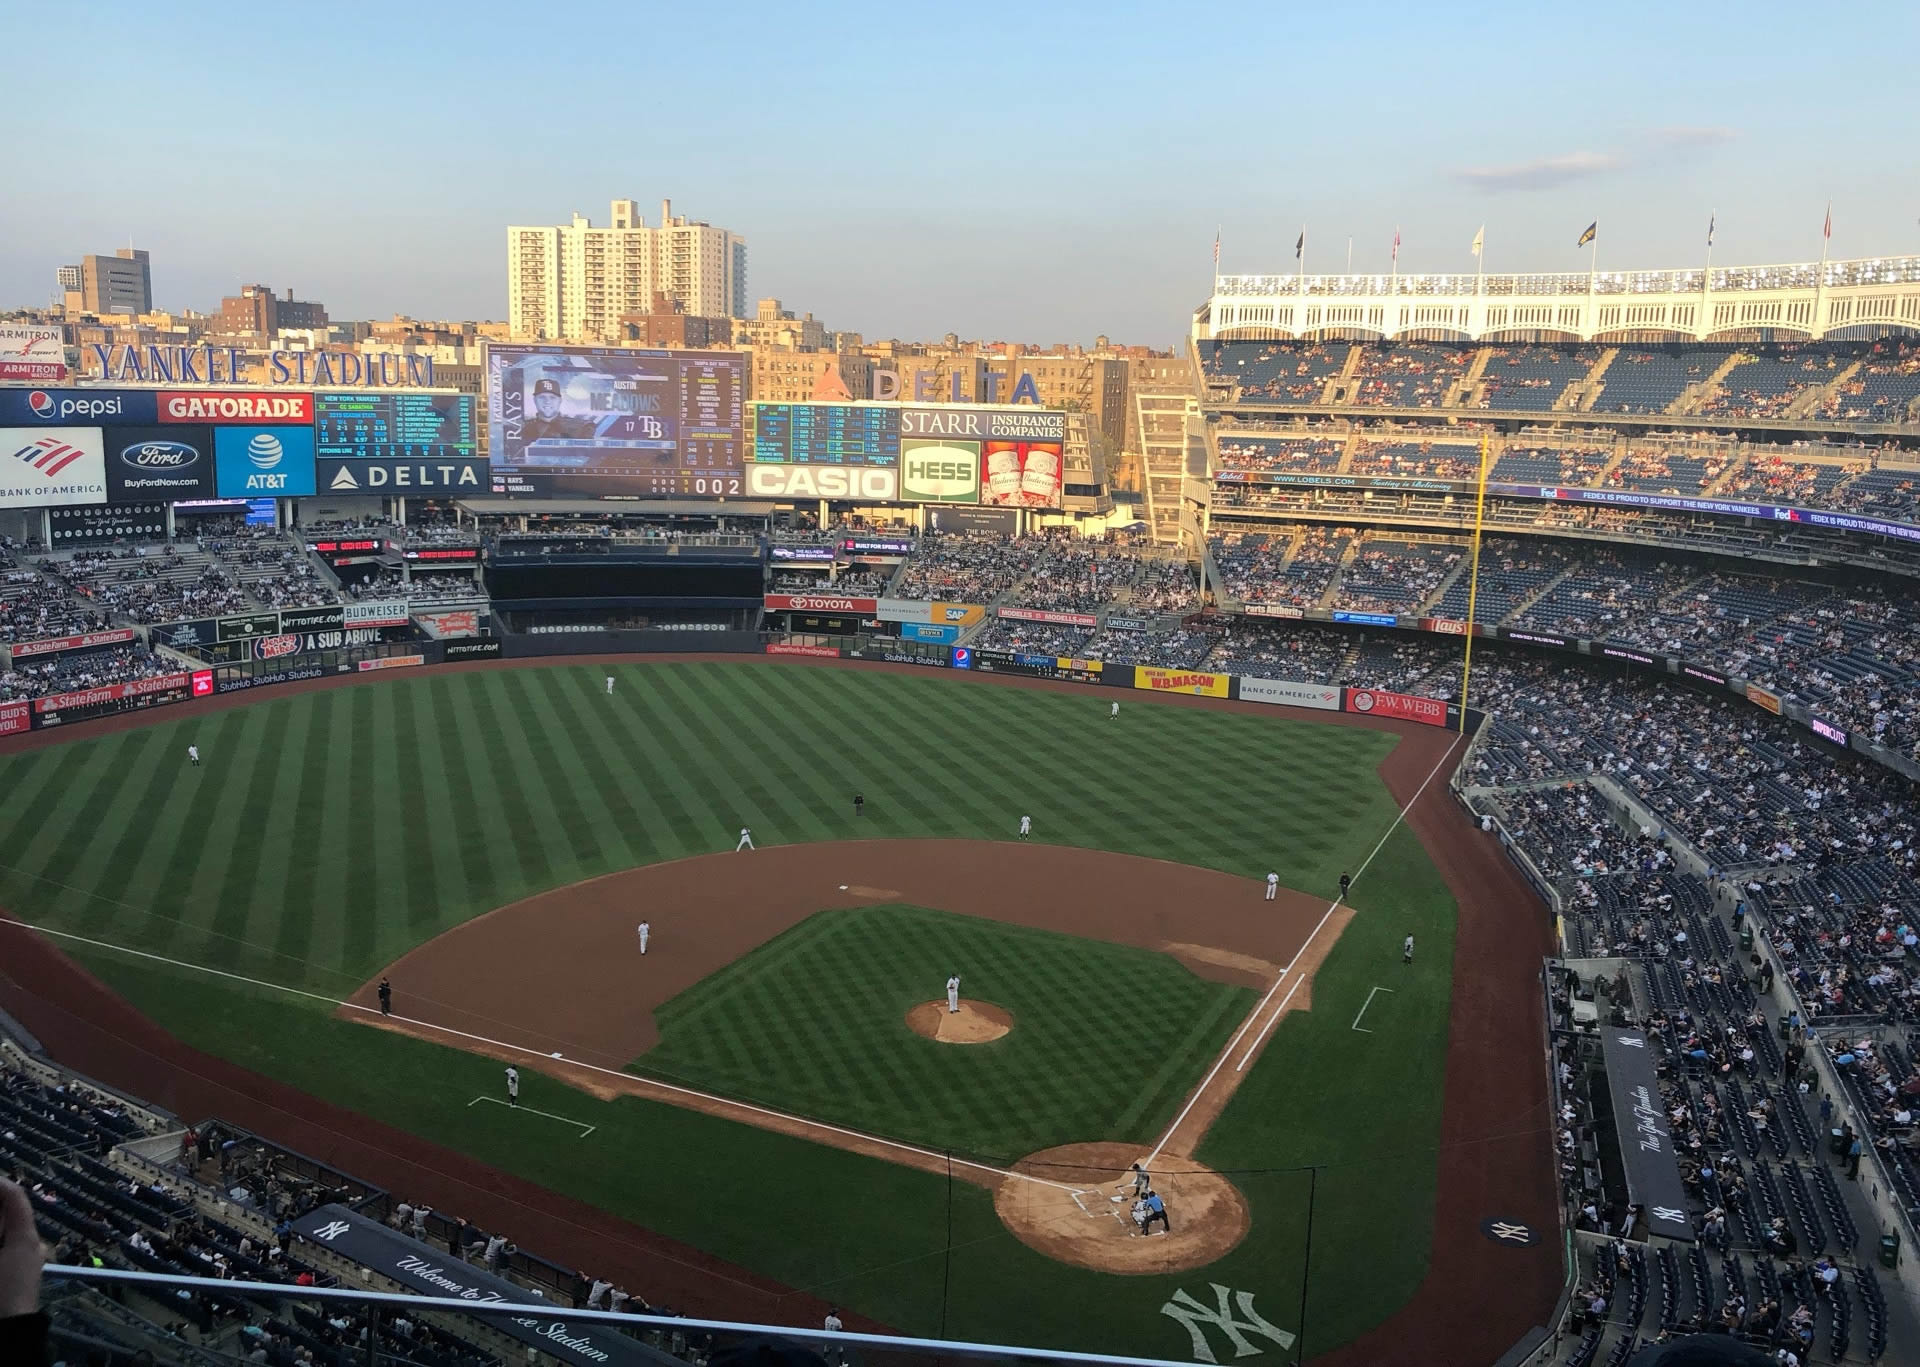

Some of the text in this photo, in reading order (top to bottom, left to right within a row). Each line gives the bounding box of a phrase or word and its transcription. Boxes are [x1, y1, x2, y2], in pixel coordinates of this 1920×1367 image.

[0, 330, 58, 340] ARMITRON
[4, 365, 58, 374] ARMITRON
[93, 344, 435, 386] YANKEE STADIUM
[614, 381, 637, 390] AUSTIN
[873, 370, 1040, 404] DELTA
[61, 396, 121, 418] pepsi
[168, 397, 304, 418] GATORADE
[505, 391, 522, 441] RAYS
[992, 415, 1064, 427] INSURANCE
[625, 421, 635, 432] 17
[638, 416, 662, 439] TB
[902, 412, 982, 435] STARR
[992, 426, 1064, 438] COMPANIES
[137, 445, 184, 465] Ford
[368, 465, 478, 486] DELTA
[909, 461, 972, 480] HESS
[125, 478, 198, 488] BuyFordNow.com
[246, 474, 288, 489] AT&T
[696, 479, 740, 495] 0 0 2
[752, 466, 894, 498] CASIO
[1273, 475, 1354, 486] WWW.LOBELS.COM
[0, 485, 103, 496] BANK OF AMERICA
[1541, 488, 1568, 498] FedEx
[1583, 492, 1606, 500] FEDEX
[1616, 494, 1640, 502] PROUD
[1640, 496, 1648, 504] TO
[1650, 496, 1682, 506] SUPPORT
[1683, 499, 1696, 508] THE
[1698, 500, 1714, 509] NEW
[1714, 504, 1730, 512] YORK
[1731, 505, 1762, 514] YANKEES.
[1774, 509, 1801, 521] FedEx
[1811, 514, 1830, 524] FEDEX
[1830, 517, 1836, 525] IS
[1836, 518, 1858, 528] PROUD
[1858, 520, 1866, 528] TO
[1867, 522, 1887, 533] SUPPORT
[1887, 526, 1896, 534] THE
[1896, 527, 1909, 536] NEW
[346, 605, 406, 618] BUDWEISER
[808, 599, 854, 610] TOYOTA
[1267, 606, 1304, 616] Authority
[281, 614, 344, 628] NITTOTIRE.COM
[946, 610, 964, 620] SAP
[862, 619, 883, 628] FedEx
[262, 634, 296, 647] Jersey
[307, 628, 382, 650] A SUB ABOVE
[1510, 632, 1564, 646] DAVID YURMAN
[448, 643, 498, 654] NITTOTIRE.COM
[775, 646, 836, 656] NewYork-Presbyterian
[884, 654, 944, 666] StubHub StubHub
[1604, 649, 1652, 664] DAVID YURMAN
[253, 674, 286, 685] StubHub
[288, 668, 322, 680] StubHub
[1684, 668, 1724, 684] DAVID YURMAN
[220, 679, 250, 692] StubHub
[1242, 686, 1264, 694] BANK
[1279, 690, 1317, 700] AMERICA
[1376, 694, 1399, 709] F.W.
[1402, 698, 1440, 716] WEBB
[1, 706, 28, 720] BUD'S
[1812, 720, 1846, 744] SUPERCUTS
[1630, 1085, 1668, 1152] New York Yankees
[396, 1254, 478, 1300] Welcome to
[536, 1322, 609, 1363] Stadium
